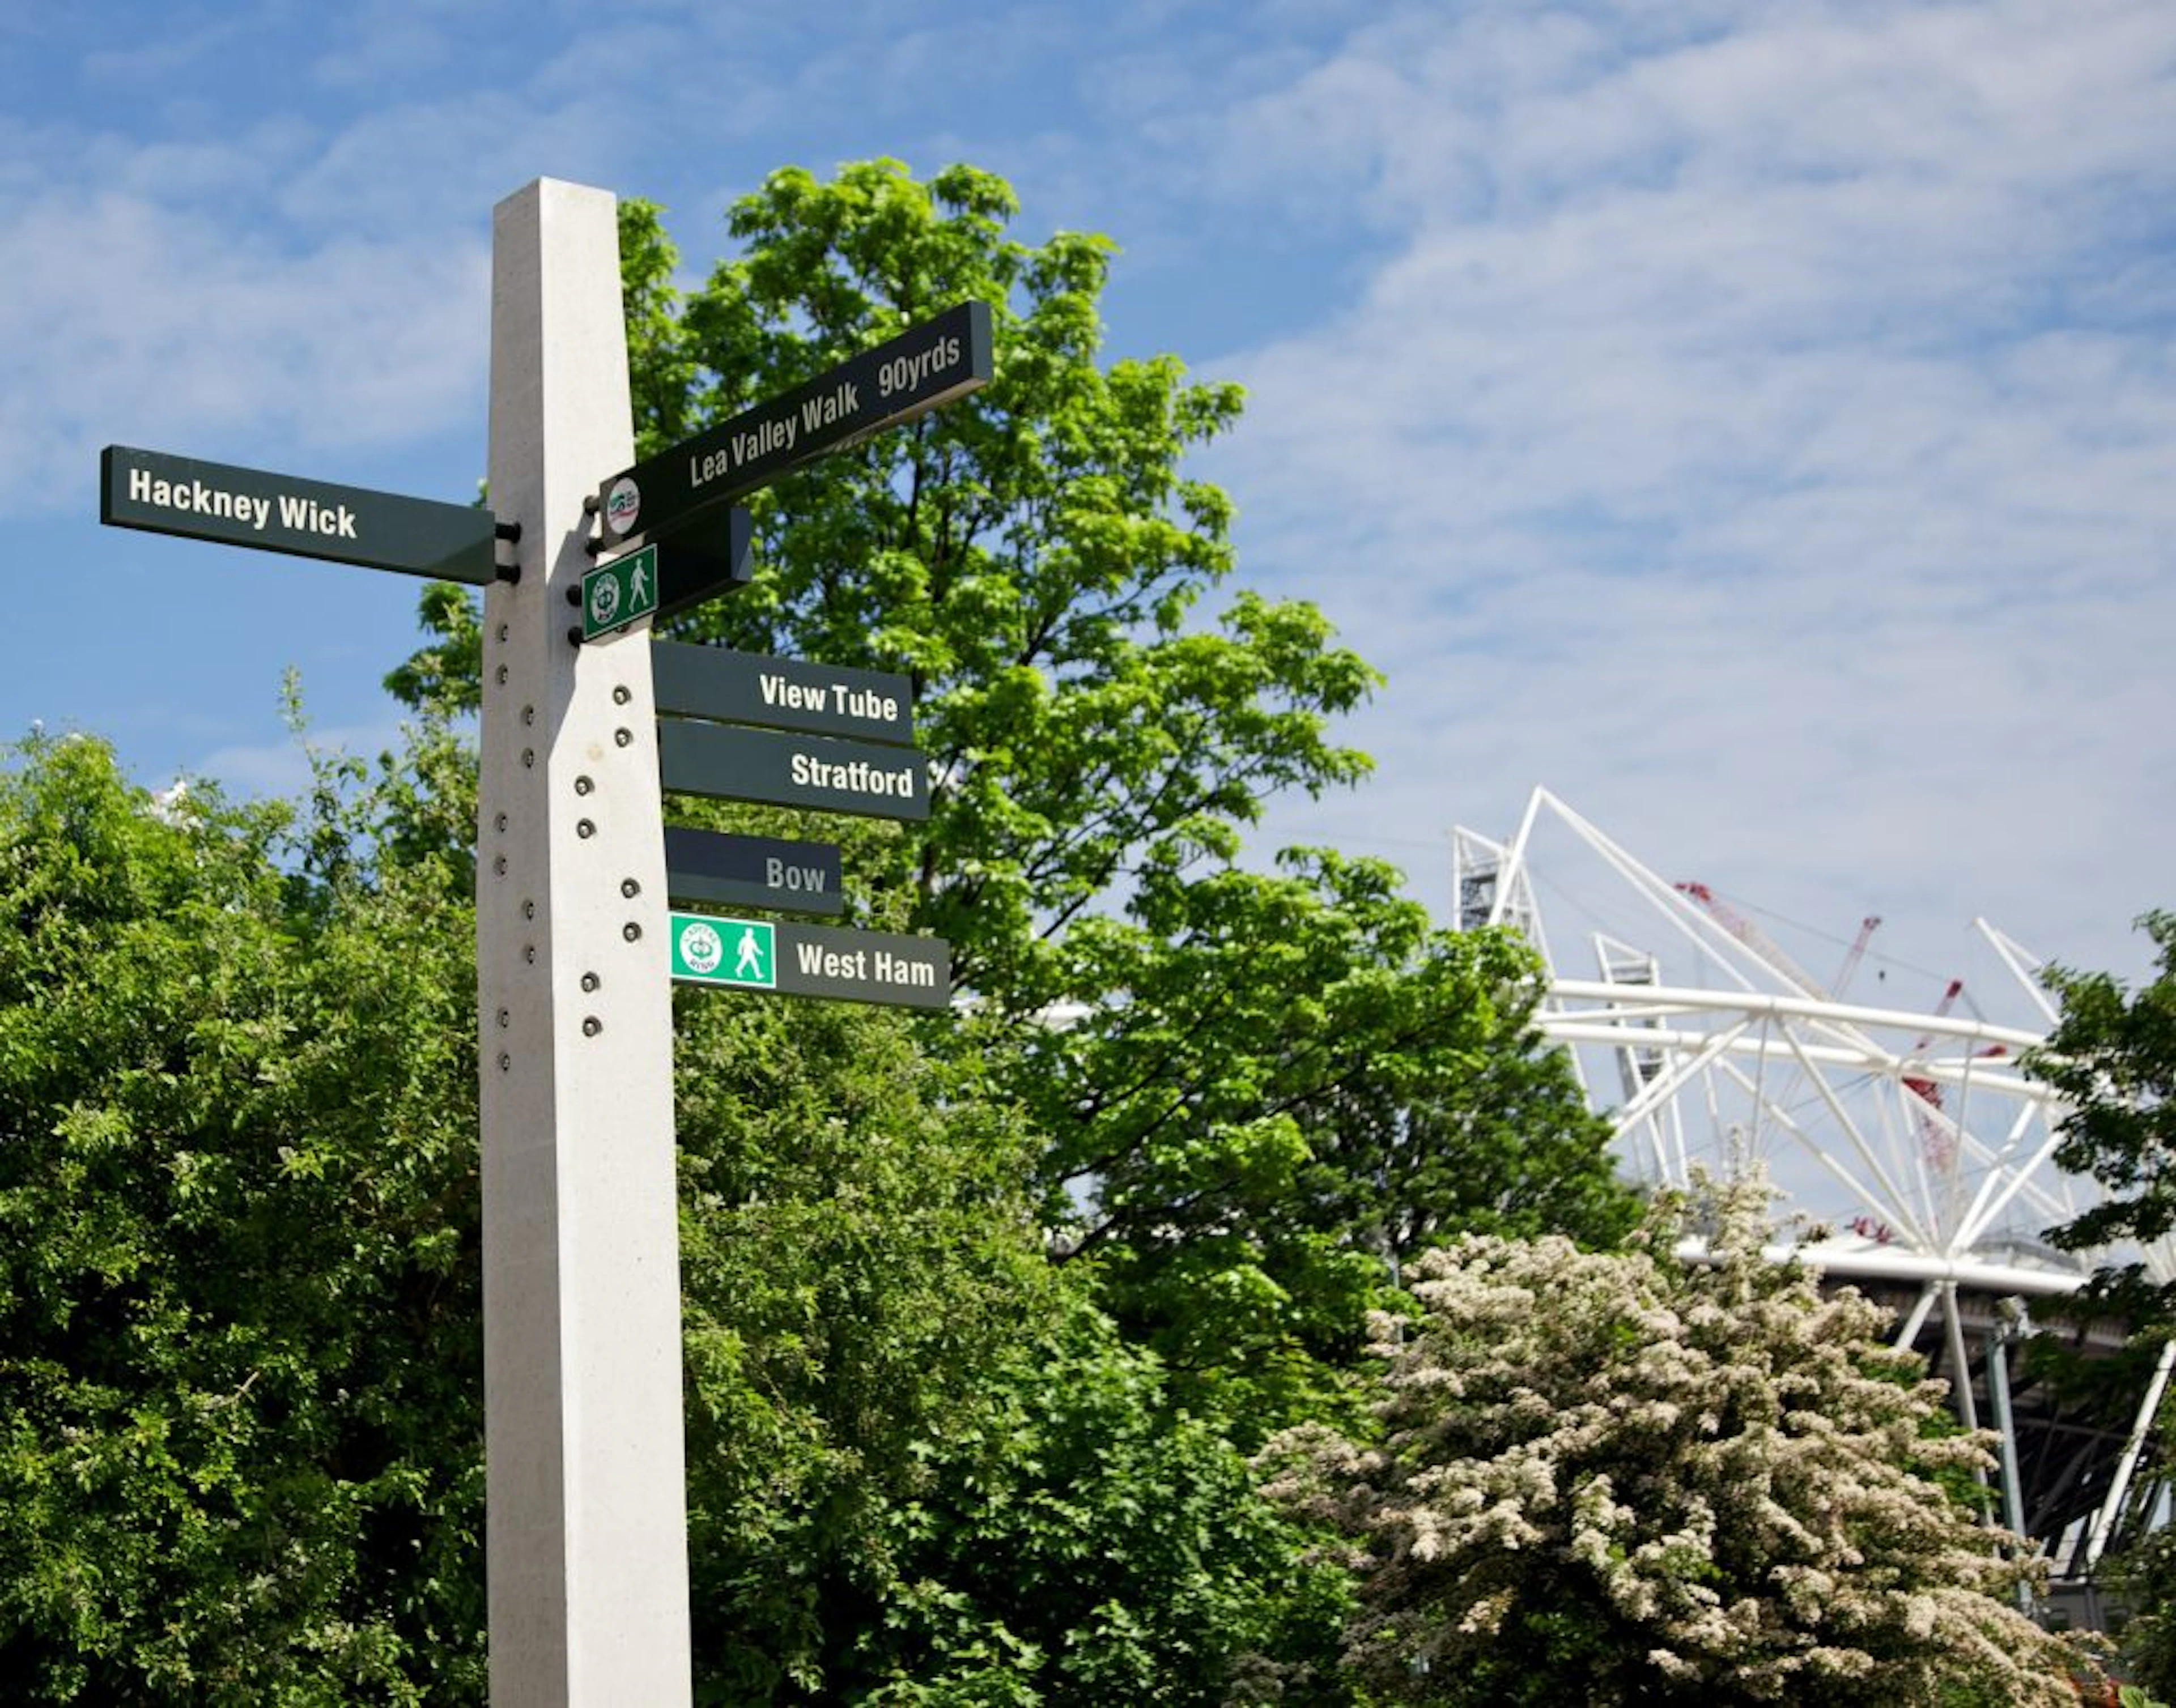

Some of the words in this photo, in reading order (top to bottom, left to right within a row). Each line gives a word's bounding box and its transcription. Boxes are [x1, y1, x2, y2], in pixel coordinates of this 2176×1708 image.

[691, 450, 727, 487] Lea
[732, 415, 797, 465] Valley
[802, 382, 859, 433] Walk
[879, 336, 960, 397] 90yrds
[130, 468, 271, 530] Hackney
[278, 496, 357, 539] Wick
[759, 674, 826, 712] View
[831, 684, 898, 722] Tube
[792, 753, 913, 798] Stratford
[767, 858, 825, 893] Bow
[797, 943, 867, 981] West
[875, 951, 934, 987] Ham
